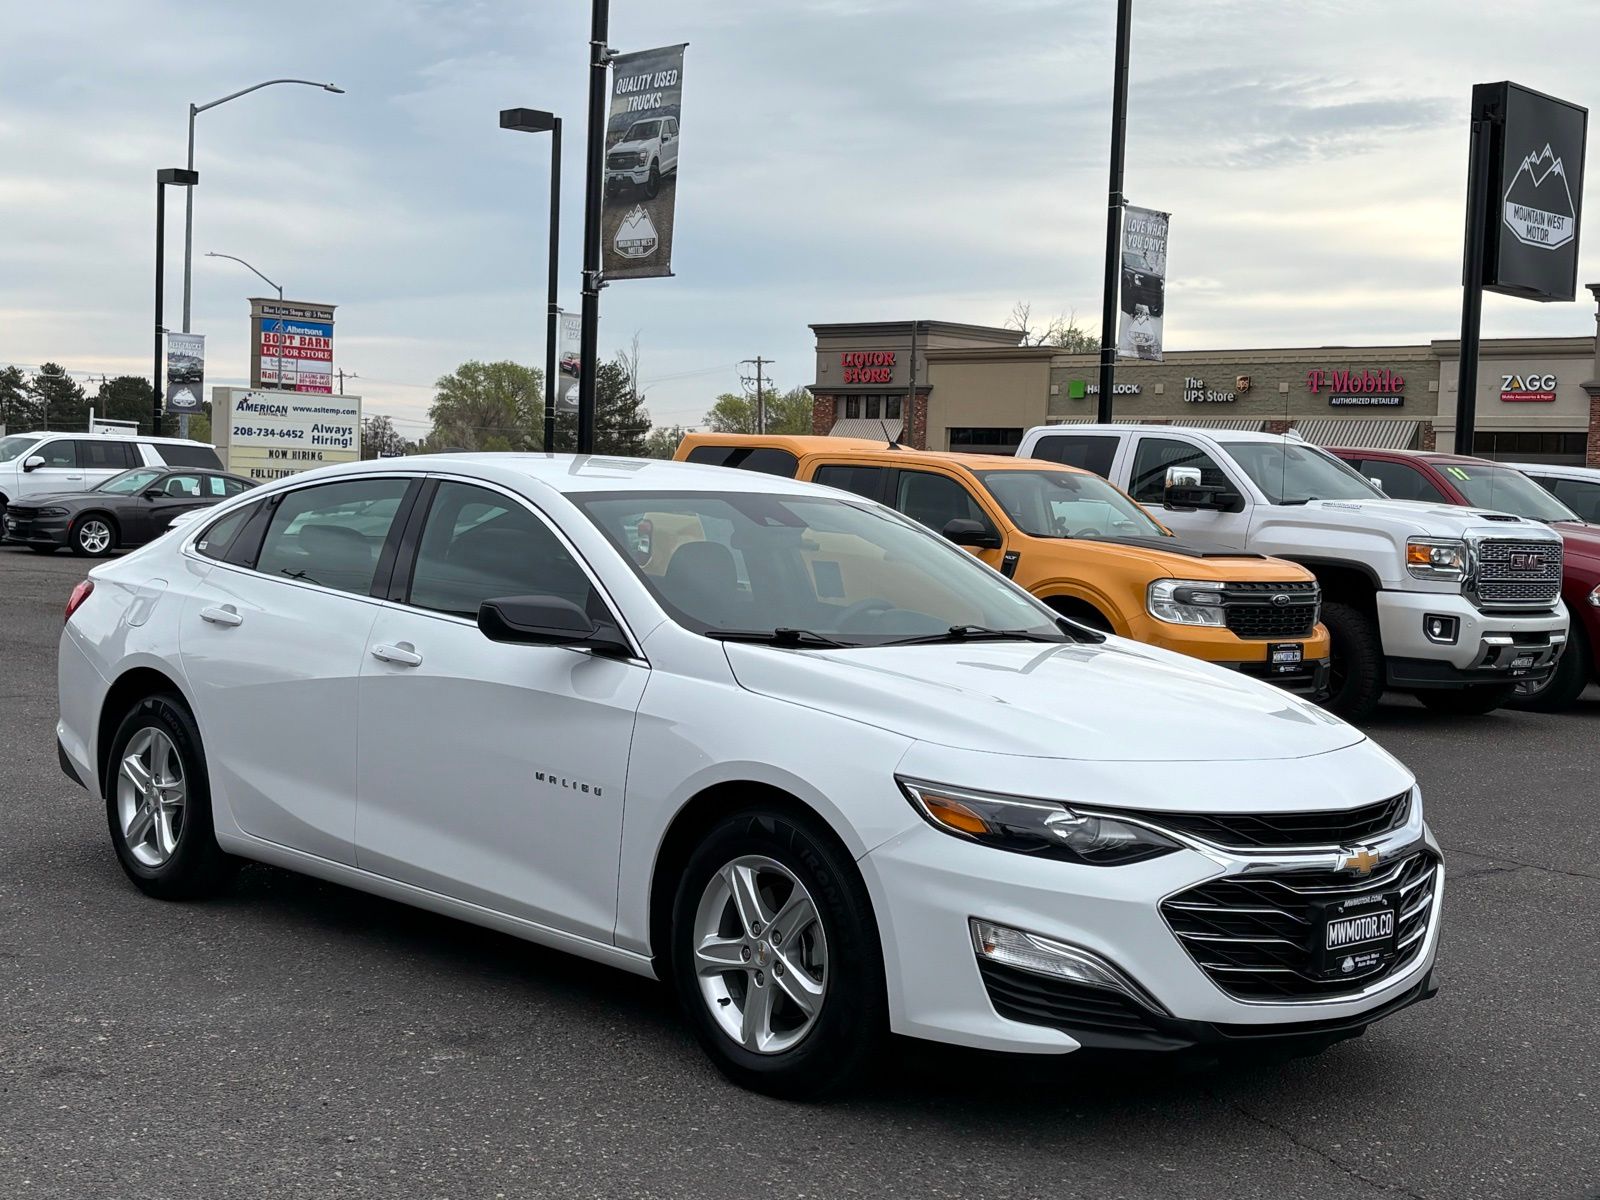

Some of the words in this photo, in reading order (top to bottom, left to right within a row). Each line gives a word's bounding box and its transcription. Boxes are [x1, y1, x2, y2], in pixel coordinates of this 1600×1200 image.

[616, 73, 653, 94] QUALITY
[653, 70, 678, 88] USED
[627, 92, 662, 112] TRUCKS
[1513, 205, 1545, 226] MOUNTAIN
[1547, 214, 1565, 231] WEST
[1127, 218, 1145, 233] LOVE
[1146, 222, 1166, 237] WHAT
[1526, 224, 1550, 242] MOTOR
[1127, 234, 1142, 248] YOU
[1144, 236, 1165, 252] DRIVE
[276, 307, 288, 315] Laes
[286, 325, 323, 336] Albertsons
[264, 333, 295, 346] BOOT
[299, 336, 330, 349] BARN
[300, 349, 331, 360] STORE
[840, 352, 895, 368] LIQUOR
[843, 368, 891, 384] STORE
[1184, 377, 1204, 389] The
[1501, 374, 1556, 391] ZAGG
[1112, 384, 1140, 394] LOCK
[1184, 390, 1205, 402] UPS
[1207, 390, 1234, 402] Store
[236, 401, 288, 414] AMERICAN
[292, 405, 357, 416] www.asitemp.com
[1331, 397, 1370, 405] AUTHORIZED
[1371, 397, 1399, 405] RETAILER
[233, 426, 304, 439] 208-734-6452
[311, 424, 353, 437] Always
[311, 435, 353, 448] Hiring!
[268, 449, 289, 459] NOW
[292, 450, 323, 461] HIRING
[1511, 554, 1545, 570] GMC
[535, 771, 602, 797] MALIBU
[1329, 914, 1392, 946] MWMOTOR.CO
